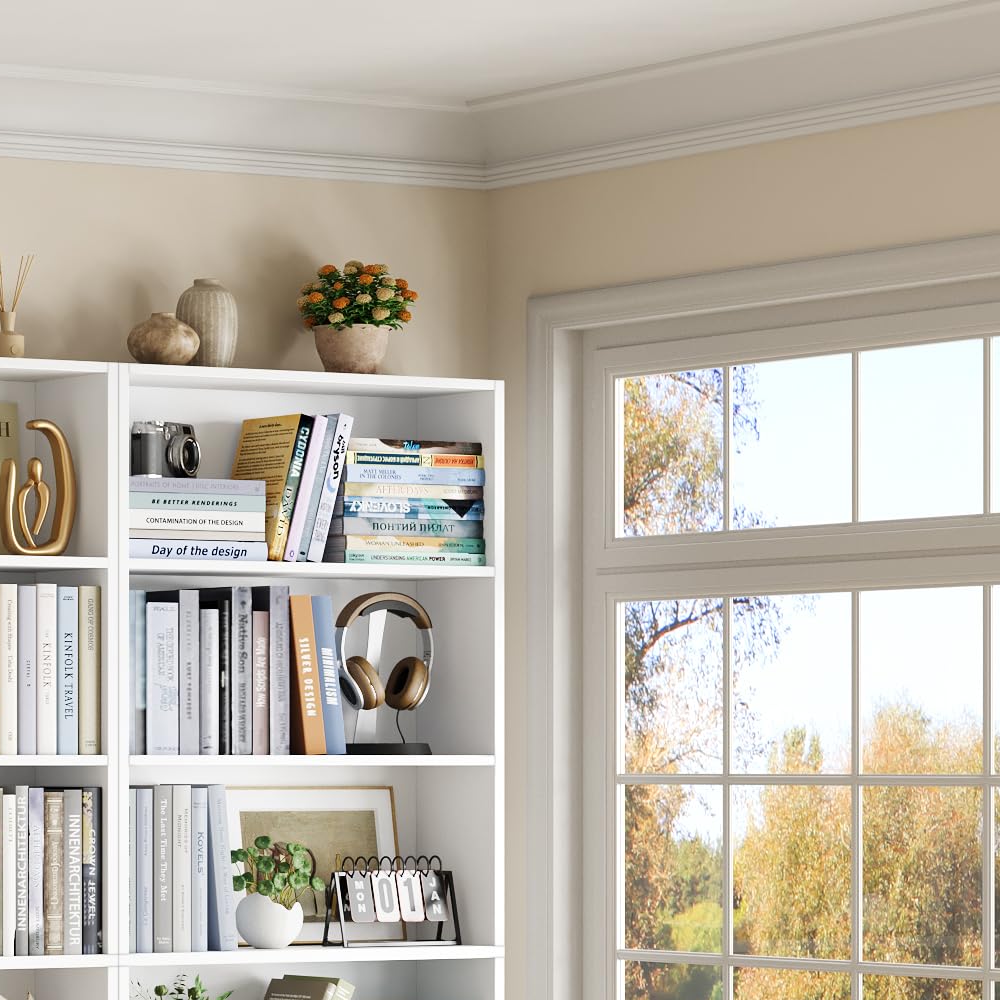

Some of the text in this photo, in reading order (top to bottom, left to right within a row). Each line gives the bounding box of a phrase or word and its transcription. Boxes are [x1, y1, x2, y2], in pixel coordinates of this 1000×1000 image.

[290, 427, 310, 477] CYDONIA
[332, 434, 344, 480] bryson
[276, 487, 293, 536] DAVID
[372, 522, 456, 532] ПОНТИЙ ПИЛАТ
[152, 545, 248, 558] Day of the design
[42, 642, 52, 688] KINFOLK
[64, 632, 74, 720] KINFOLK TRAVEL
[298, 637, 316, 717] SILVER DESIGN
[320, 648, 338, 706] MINIMALISM
[17, 796, 26, 931] INNENARCHITEKTUR
[68, 814, 80, 946] INNENARCHITEKTUR
[354, 880, 366, 912] MON
[378, 878, 416, 914] 01
[429, 878, 442, 914] JAN
